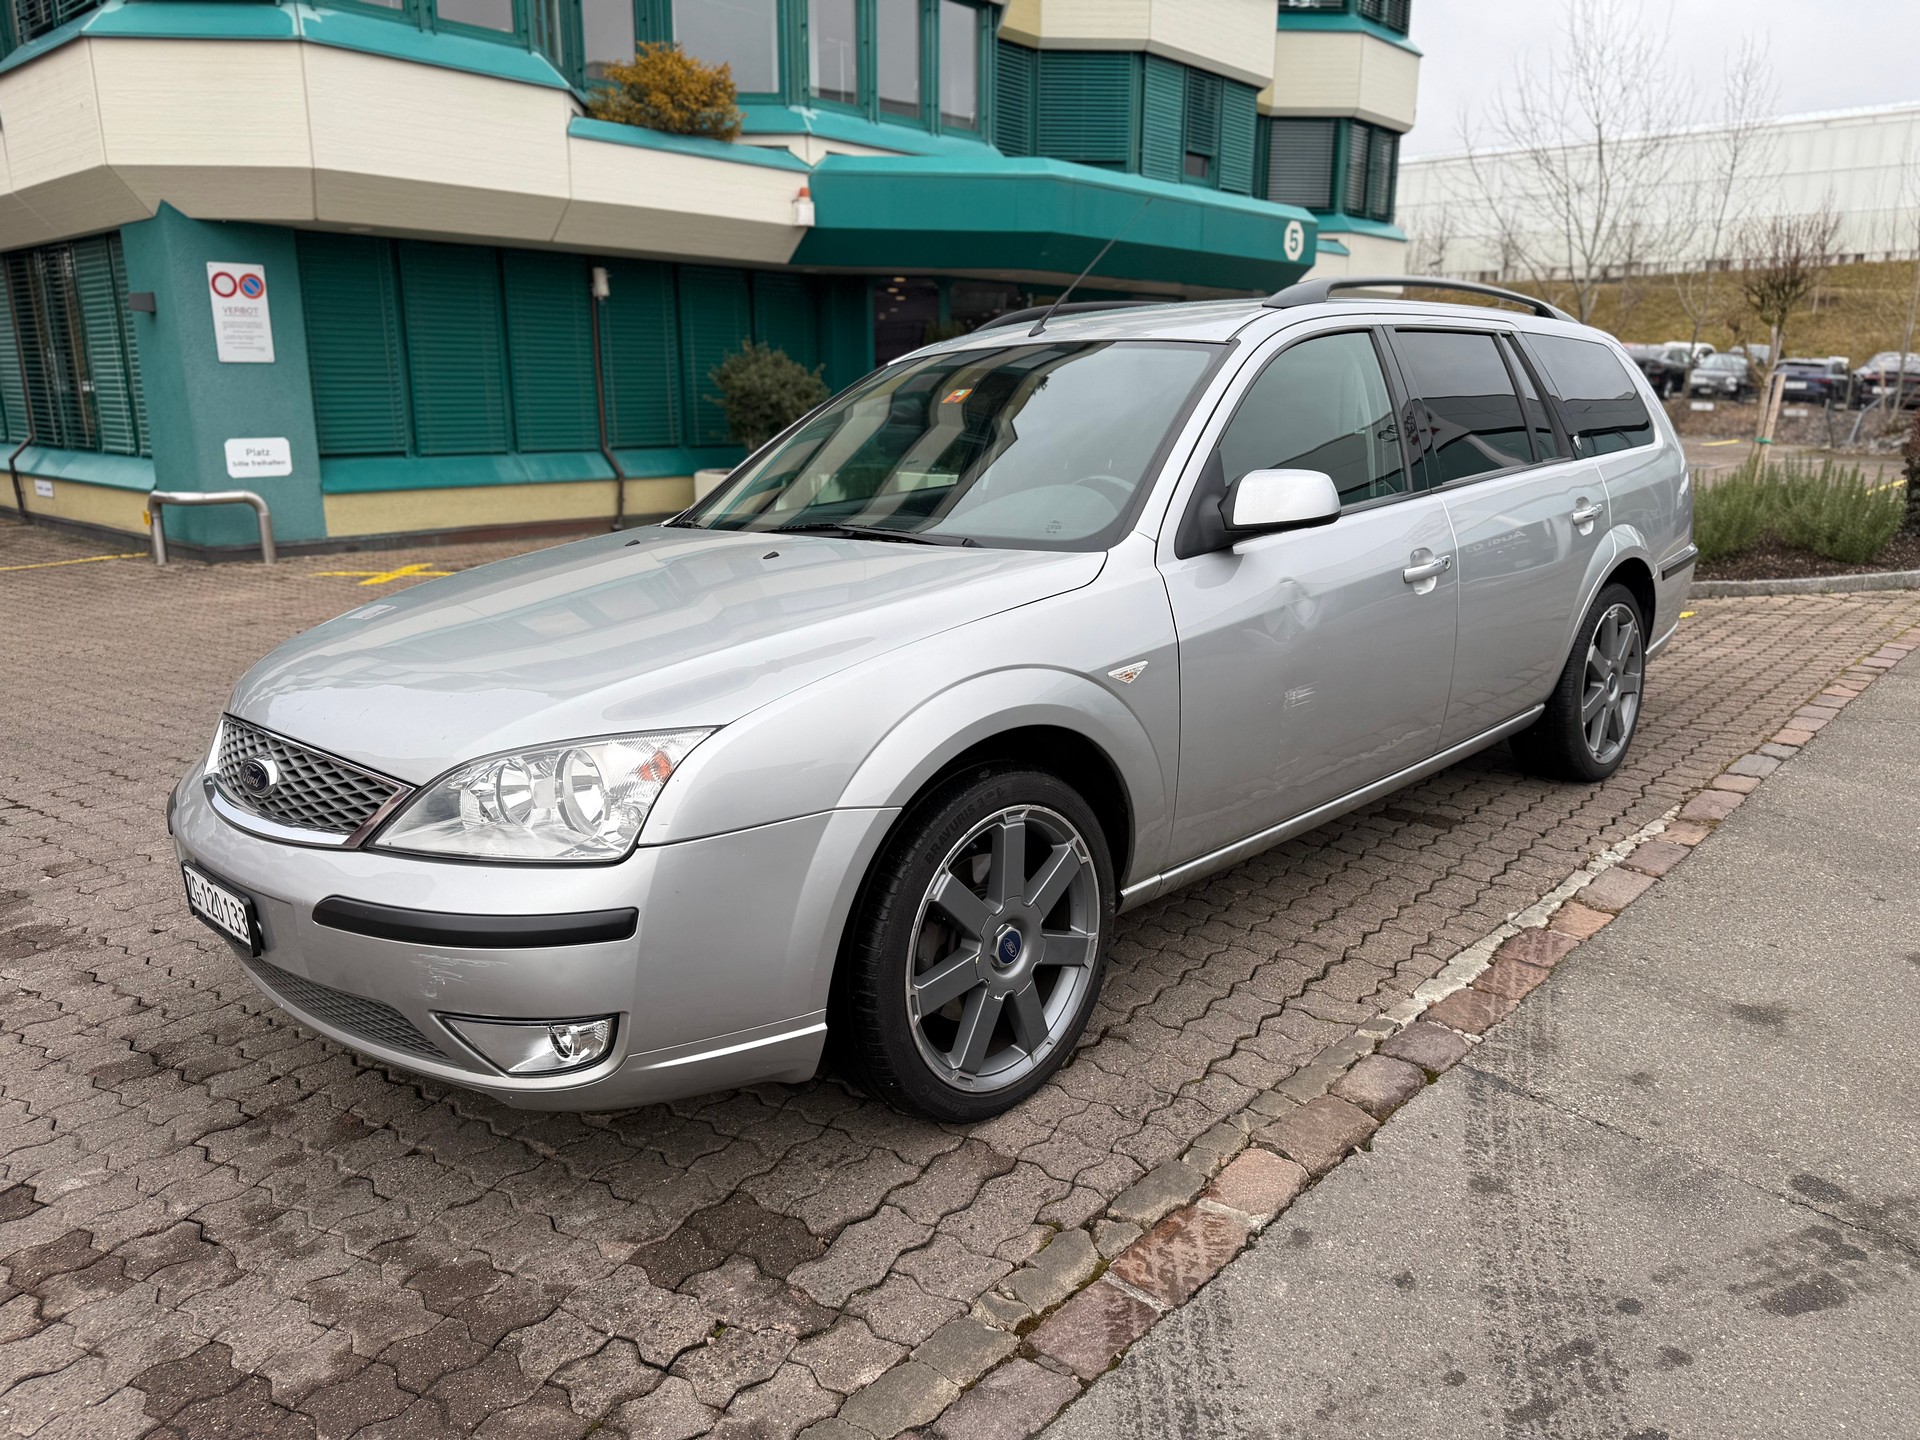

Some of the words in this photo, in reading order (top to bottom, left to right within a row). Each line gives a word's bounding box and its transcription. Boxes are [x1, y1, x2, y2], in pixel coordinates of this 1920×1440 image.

[1289, 228, 1299, 252] 5
[222, 306, 259, 316] VERBOT
[245, 448, 271, 457] Platz
[242, 764, 262, 788] Ford
